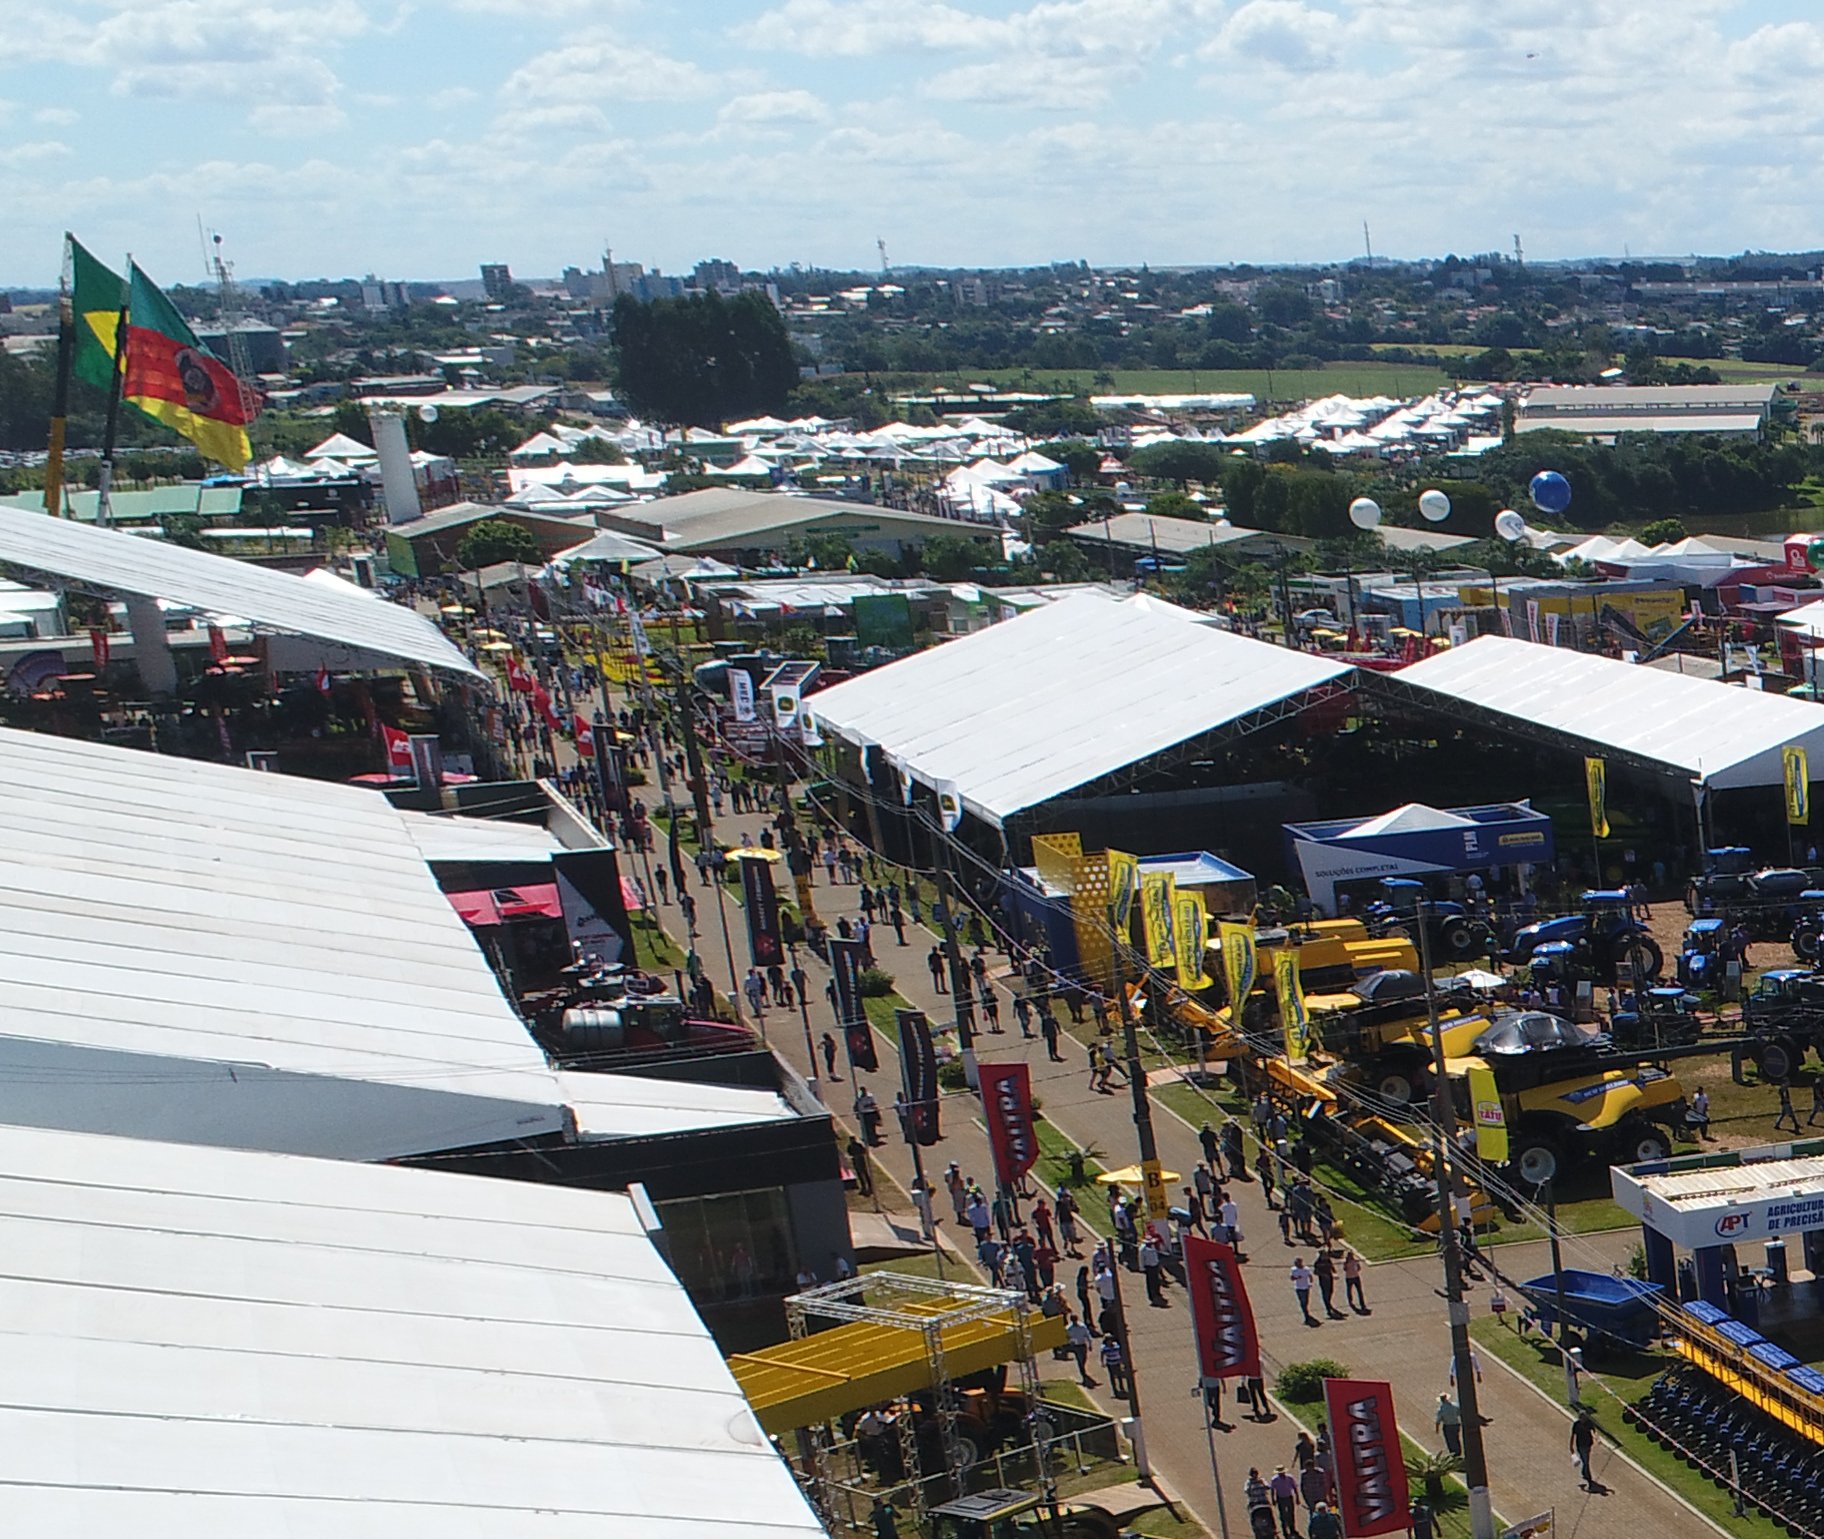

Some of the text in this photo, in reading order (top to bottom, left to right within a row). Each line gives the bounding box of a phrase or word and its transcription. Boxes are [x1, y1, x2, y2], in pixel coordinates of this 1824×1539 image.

[1315, 866, 1354, 878] SOLUÇÕES
[995, 1076, 1030, 1164] VALTRA
[1479, 1107, 1502, 1121] TATU
[1149, 1172, 1160, 1188] B
[1719, 1213, 1750, 1233] APT
[1768, 1219, 1780, 1231] DE
[1207, 1259, 1245, 1368] VALTRA
[1345, 1396, 1390, 1524] VALTRA
